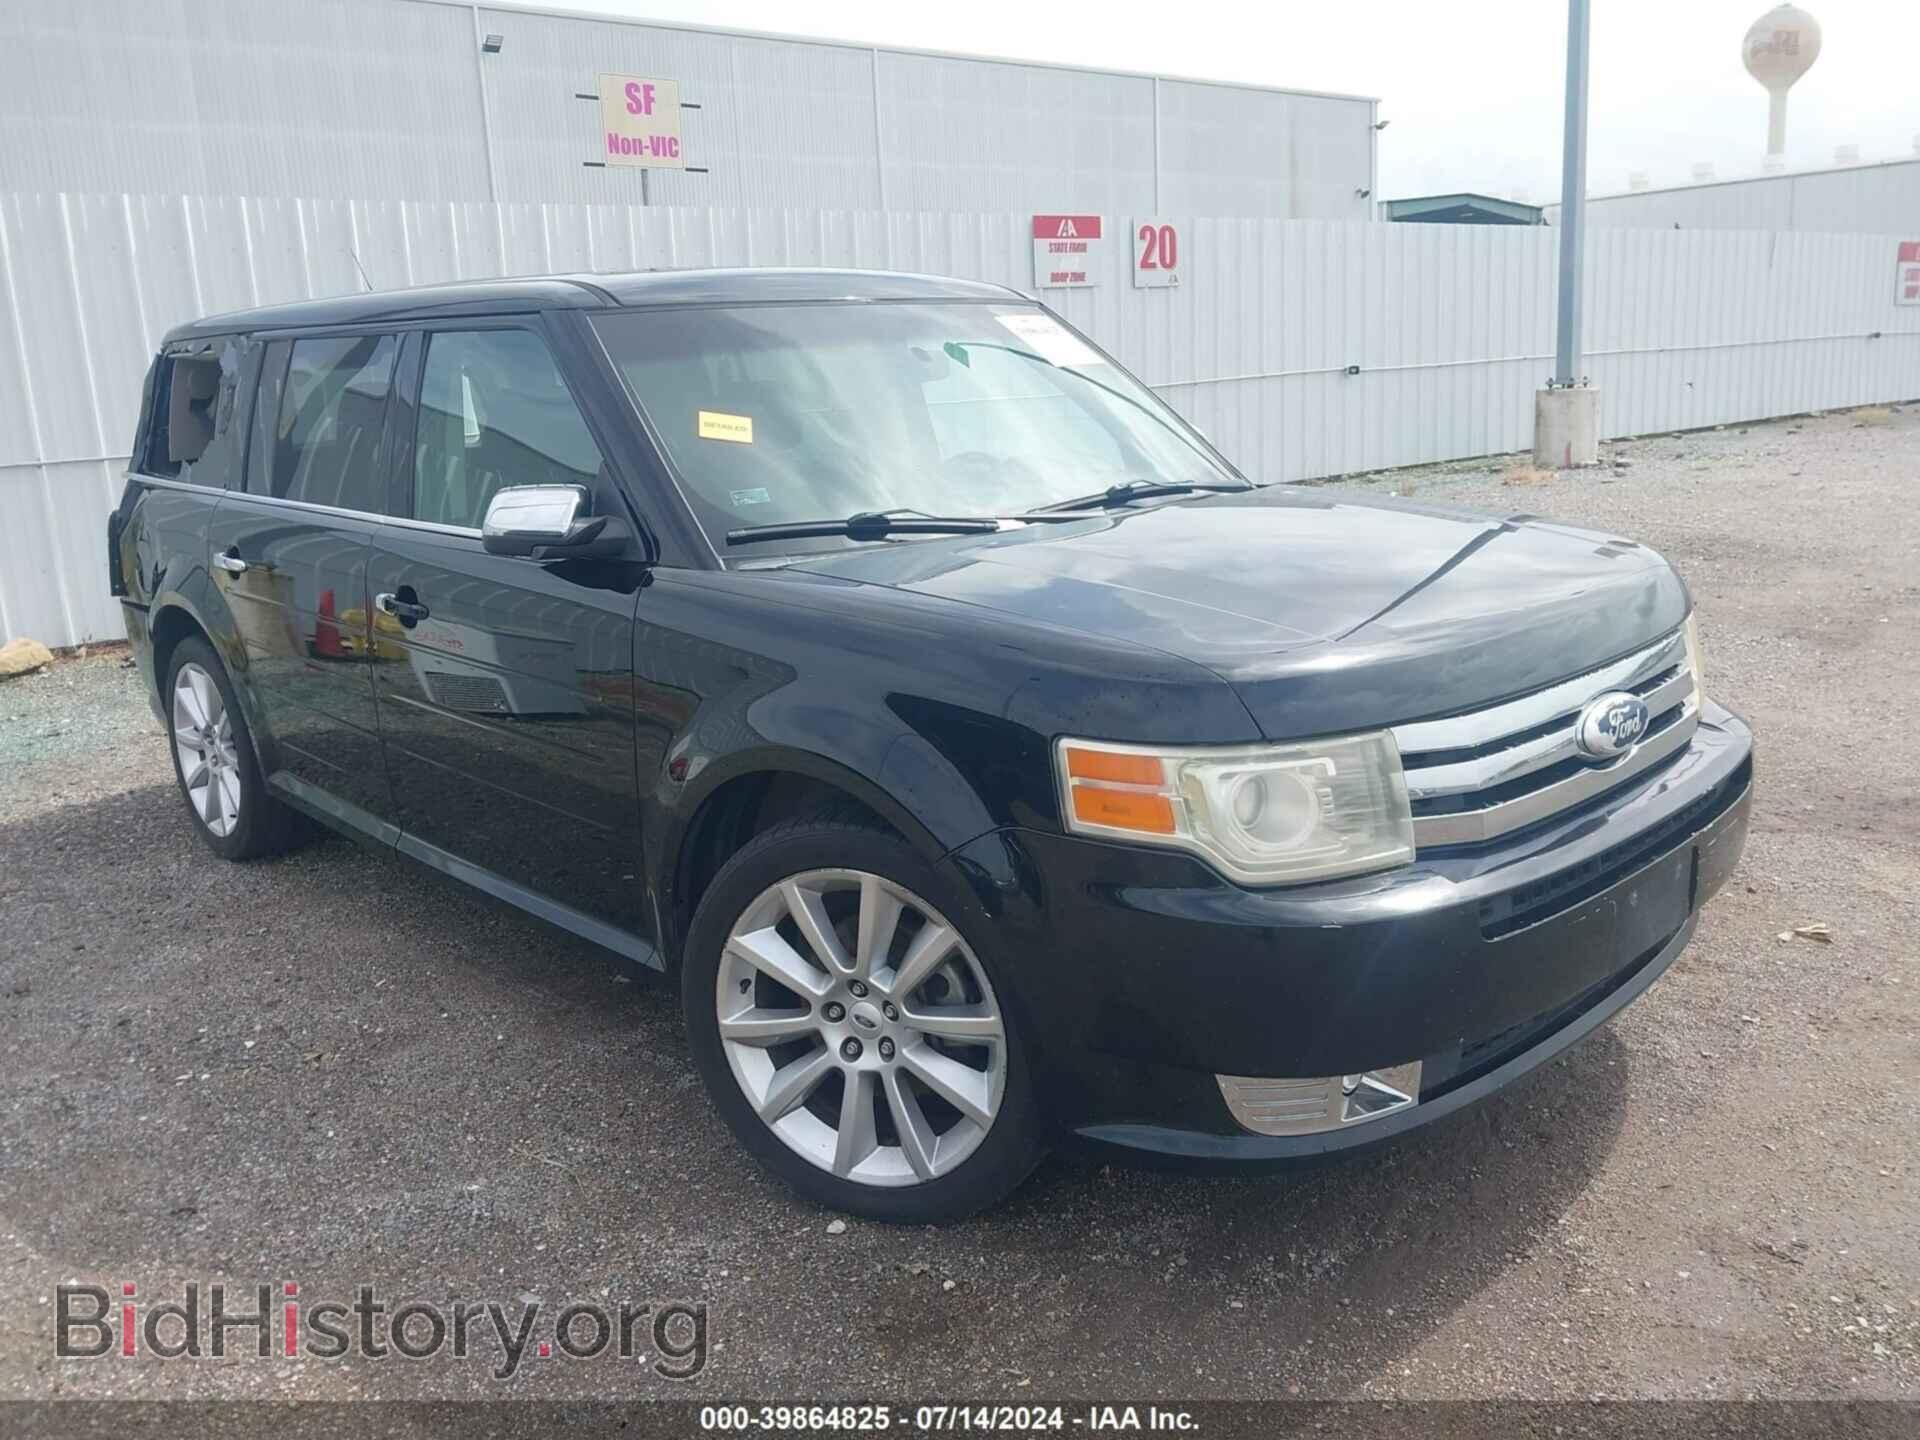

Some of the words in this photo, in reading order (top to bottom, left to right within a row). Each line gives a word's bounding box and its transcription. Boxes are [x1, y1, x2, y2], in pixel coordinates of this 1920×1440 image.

[625, 82, 655, 115] SF
[607, 132, 679, 158] Non-VIC
[1139, 225, 1176, 269] 20
[1609, 705, 1642, 739] Ford
